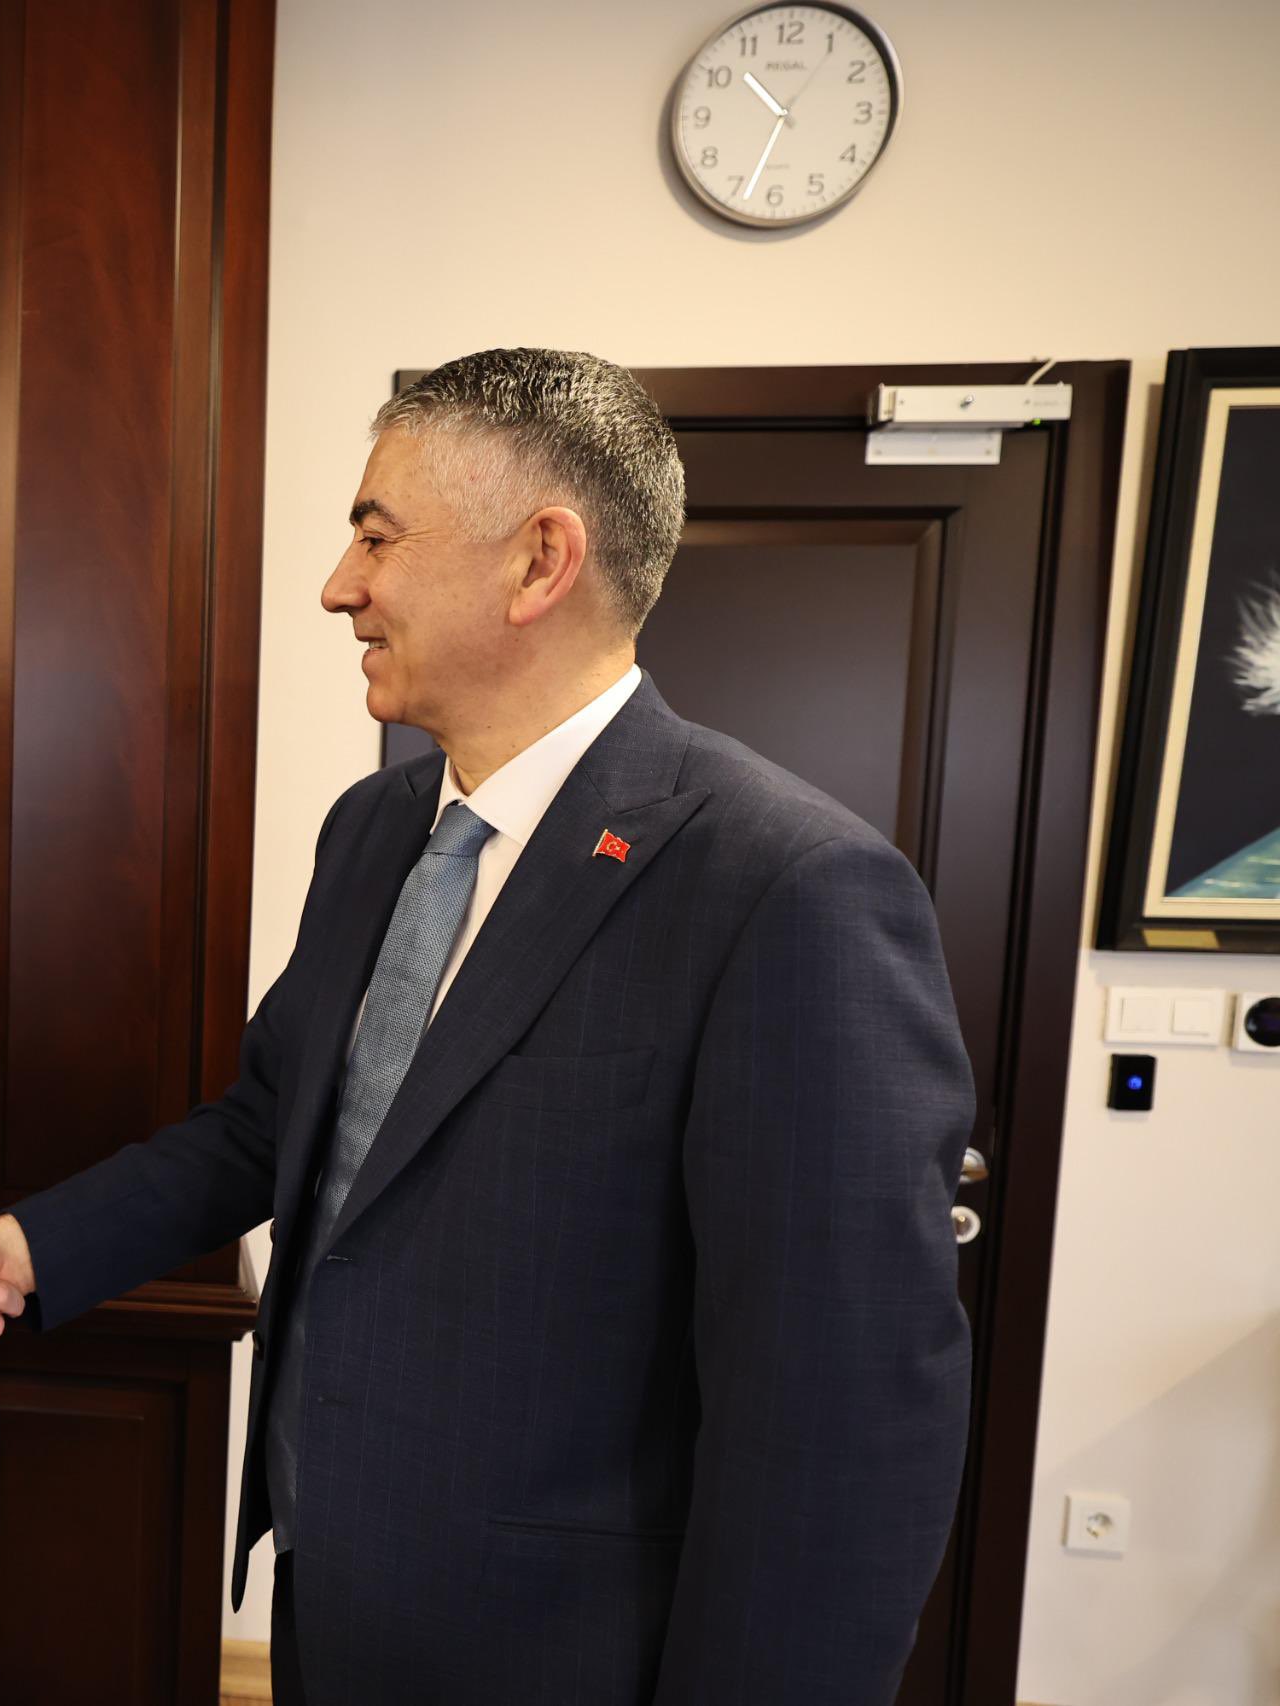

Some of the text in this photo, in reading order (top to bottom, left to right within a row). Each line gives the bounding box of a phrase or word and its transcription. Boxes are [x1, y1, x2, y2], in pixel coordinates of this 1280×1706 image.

[777, 20, 805, 45] 12
[826, 32, 834, 54] 1
[740, 35, 758, 57] 11
[707, 65, 732, 89] 10
[846, 60, 866, 84] 2
[694, 106, 711, 129] 9
[853, 101, 873, 125] 3
[700, 146, 718, 169] 8
[839, 143, 856, 163] 4
[727, 175, 745, 197] 7
[766, 184, 784, 207] 6
[807, 173, 825, 196] 5
